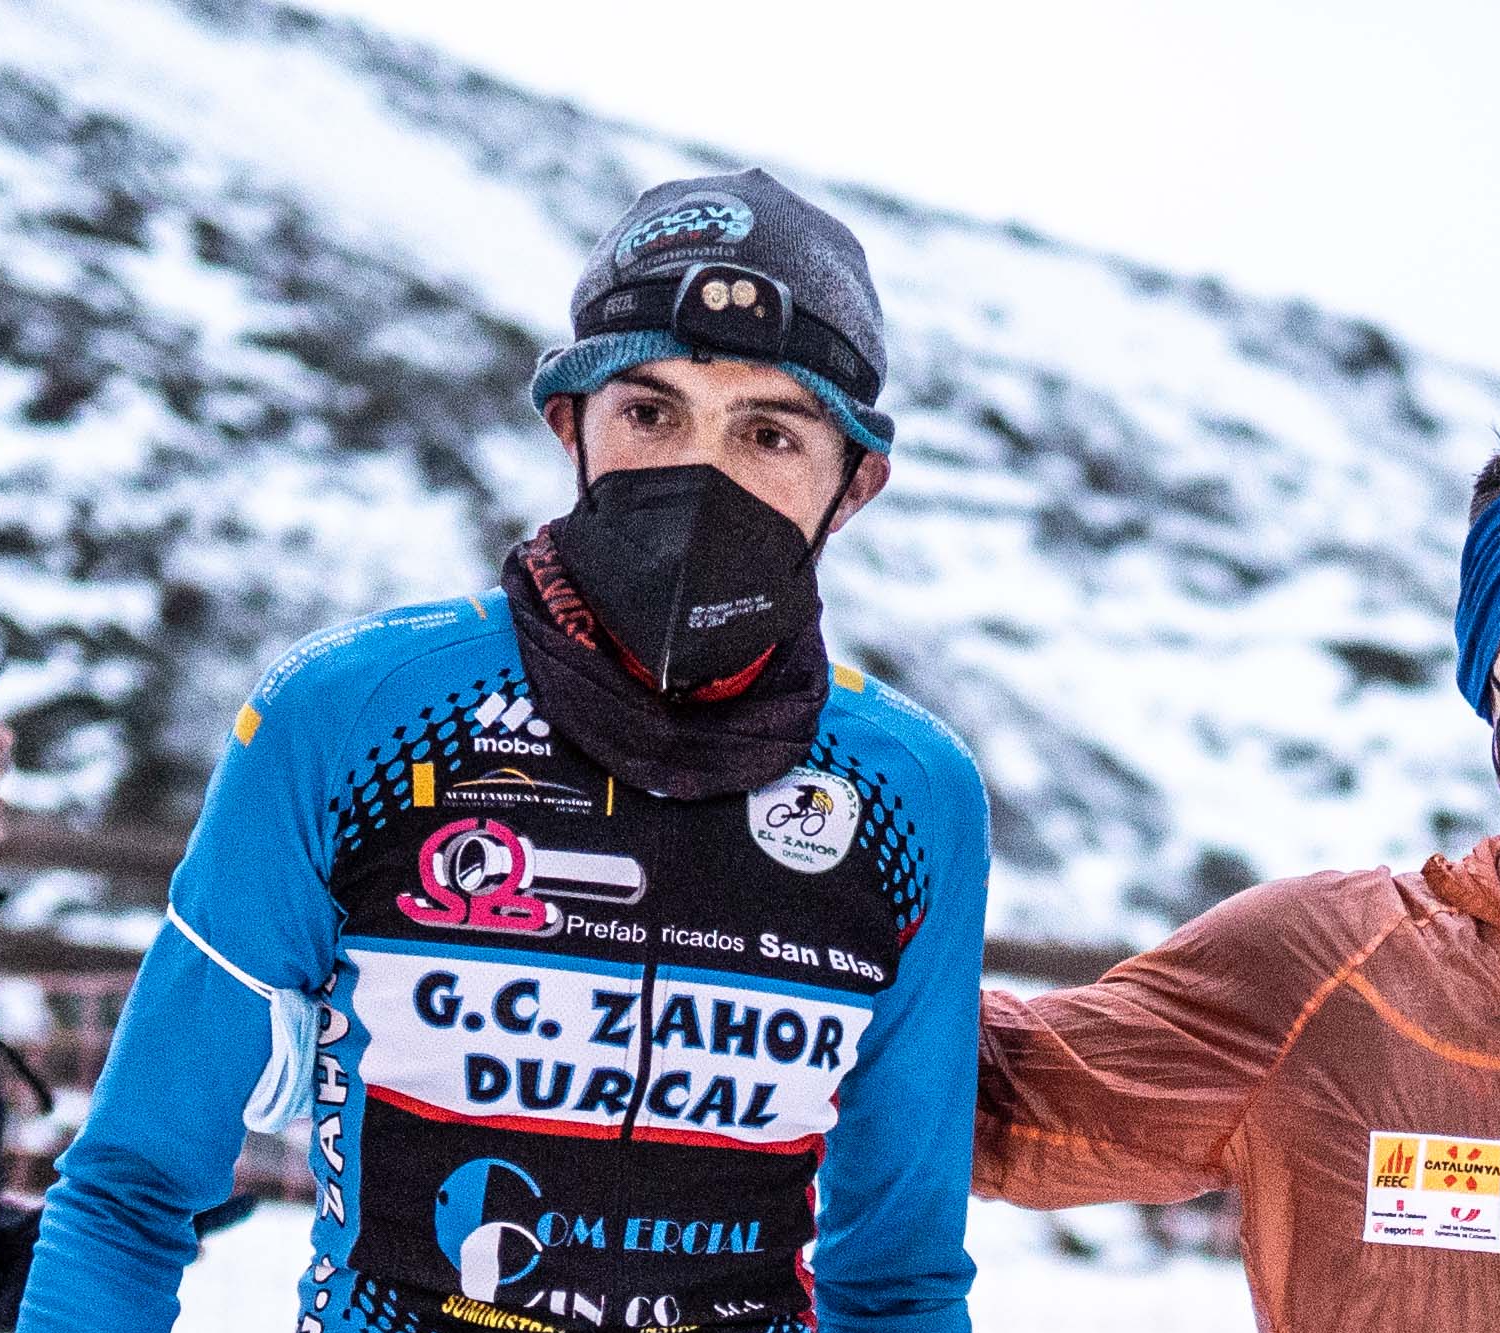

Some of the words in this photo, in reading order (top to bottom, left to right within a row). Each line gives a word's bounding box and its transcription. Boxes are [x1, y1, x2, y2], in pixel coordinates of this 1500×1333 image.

[757, 830, 776, 842] EL
[783, 836, 838, 858] ZAHOR
[759, 932, 820, 967] San
[829, 949, 885, 983] Blas
[412, 969, 563, 1040] G.C.
[589, 988, 845, 1072] ZAHOR
[464, 1051, 778, 1129] DURCAL
[1375, 1175, 1410, 1189] FEEC
[1424, 1159, 1500, 1176] CATALUNYA
[441, 1294, 566, 1333] SUMINISTR
